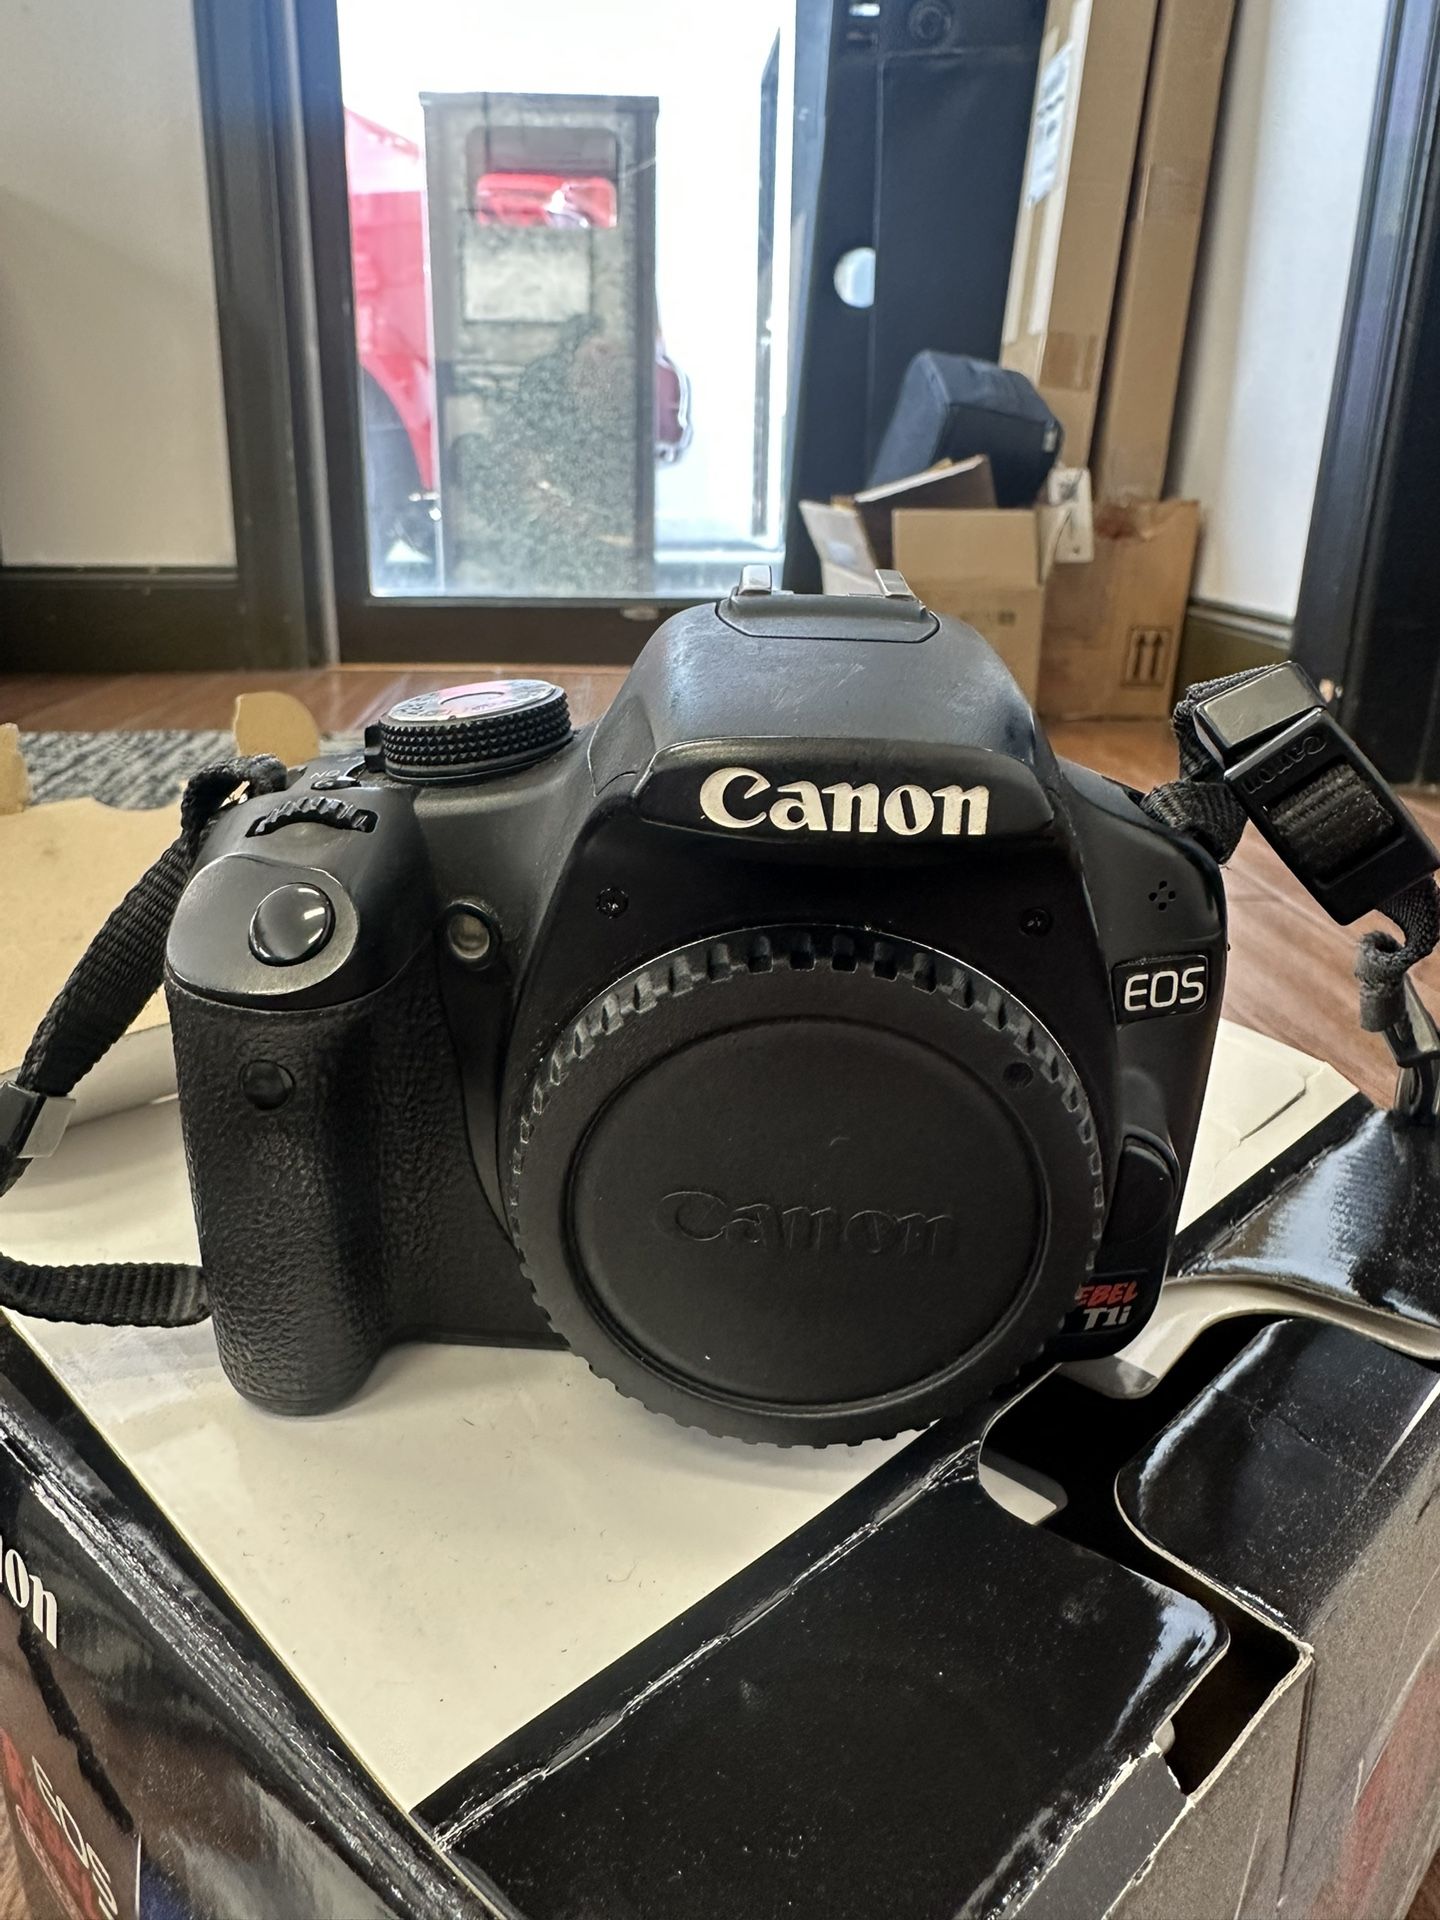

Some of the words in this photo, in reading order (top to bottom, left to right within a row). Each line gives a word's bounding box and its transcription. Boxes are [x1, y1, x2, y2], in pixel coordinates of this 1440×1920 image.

[1241, 736, 1328, 796] Canon
[699, 766, 990, 836] Canon
[1124, 966, 1206, 1011] EOS
[652, 1190, 957, 1256] Canon
[1074, 1281, 1138, 1307] EBEL
[1082, 1305, 1133, 1331] T1i
[0, 1534, 58, 1649] on
[31, 1755, 119, 1916] EOS
